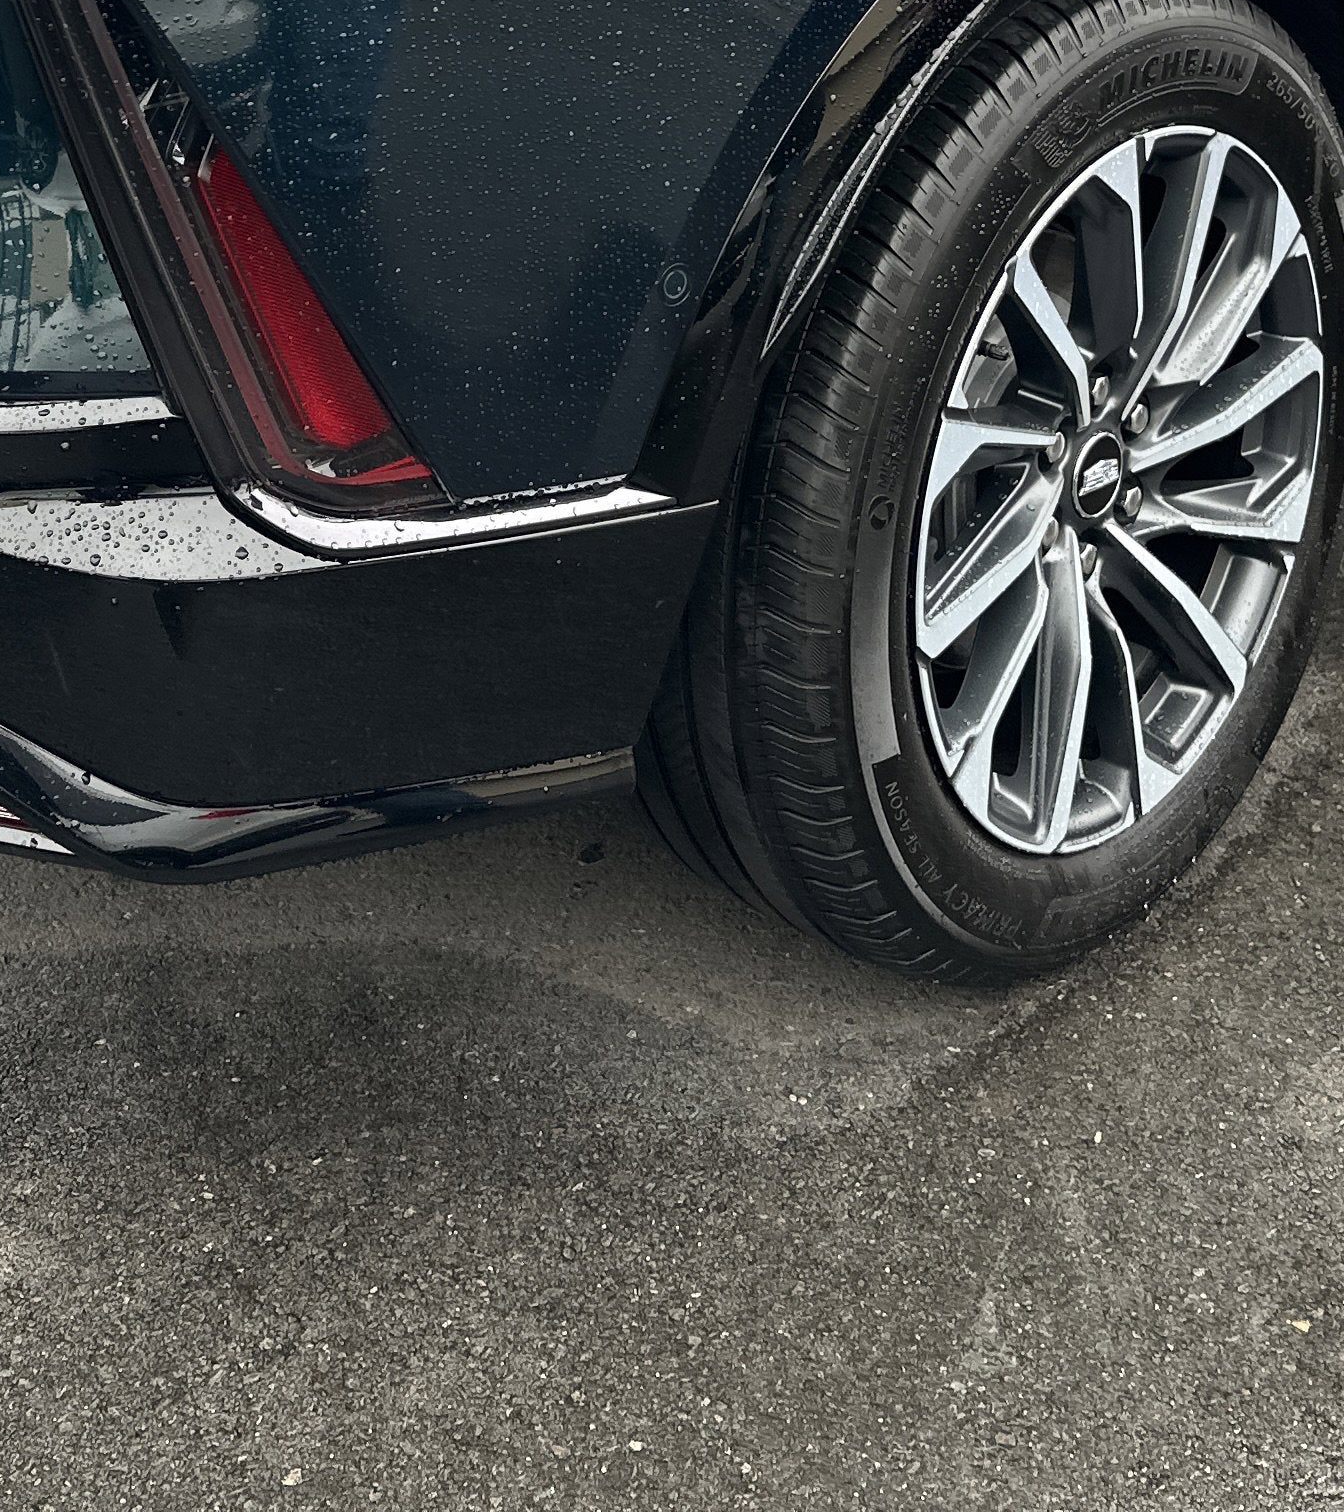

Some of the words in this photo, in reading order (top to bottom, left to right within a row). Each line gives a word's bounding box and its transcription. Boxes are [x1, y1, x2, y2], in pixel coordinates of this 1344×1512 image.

[1099, 47, 1248, 108] MICHELIN
[1266, 72, 1316, 130] 265/50
[884, 781, 923, 855] SEASON
